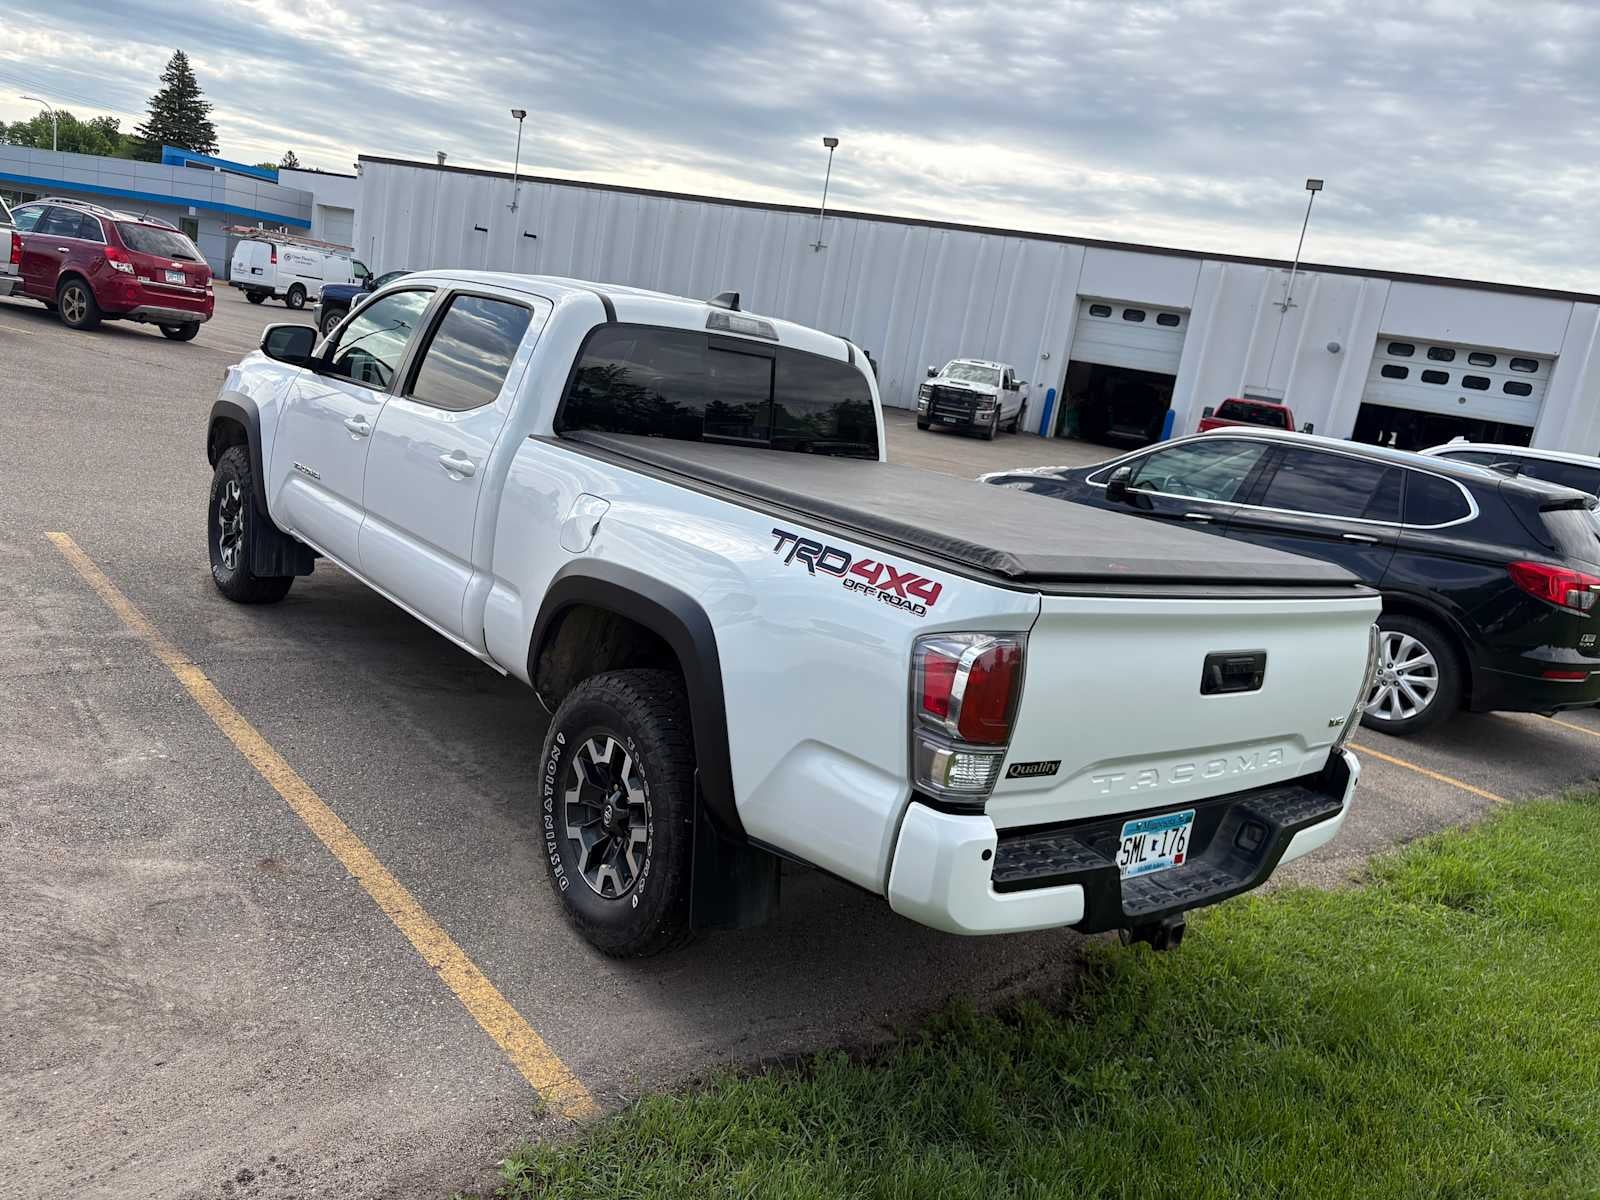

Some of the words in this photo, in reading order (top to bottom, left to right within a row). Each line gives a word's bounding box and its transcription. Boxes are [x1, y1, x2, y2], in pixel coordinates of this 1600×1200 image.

[771, 528, 852, 577] TRD
[842, 577, 878, 596] OFF
[876, 591, 927, 617] ROAD
[1009, 761, 1060, 777] Quality
[1091, 747, 1284, 794] TACOMA
[1120, 834, 1148, 866] SML
[1158, 826, 1187, 858] 176
